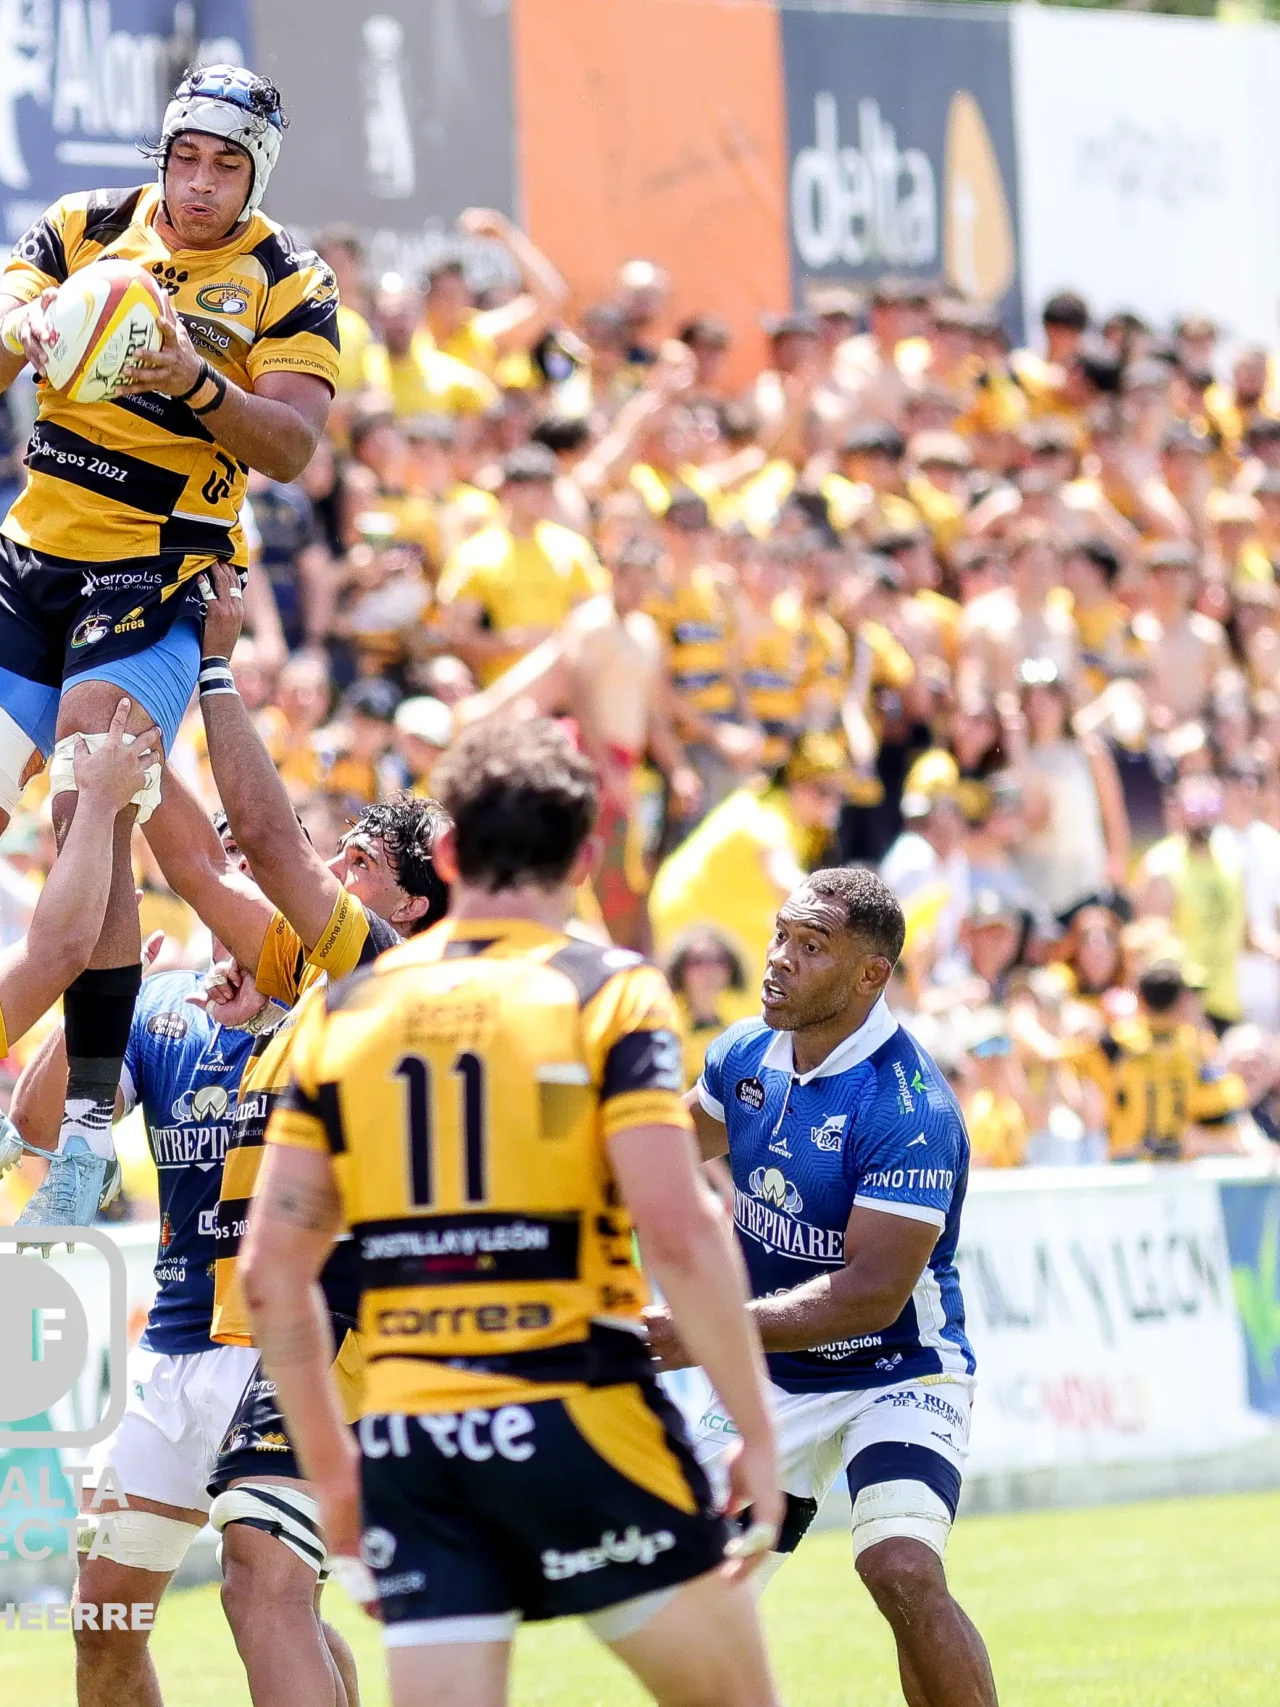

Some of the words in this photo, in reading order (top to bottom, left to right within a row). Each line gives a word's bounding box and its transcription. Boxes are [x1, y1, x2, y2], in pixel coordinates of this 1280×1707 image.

[791, 91, 938, 268] delta
[87, 457, 128, 482] 2031
[114, 618, 145, 634] errea
[319, 925, 341, 959] BURGOS
[740, 1091, 761, 1108] Galicia
[741, 1083, 763, 1100] Estrella
[392, 1051, 490, 1210] 11
[377, 1301, 553, 1337] correa
[914, 1402, 956, 1429] ZAMORA
